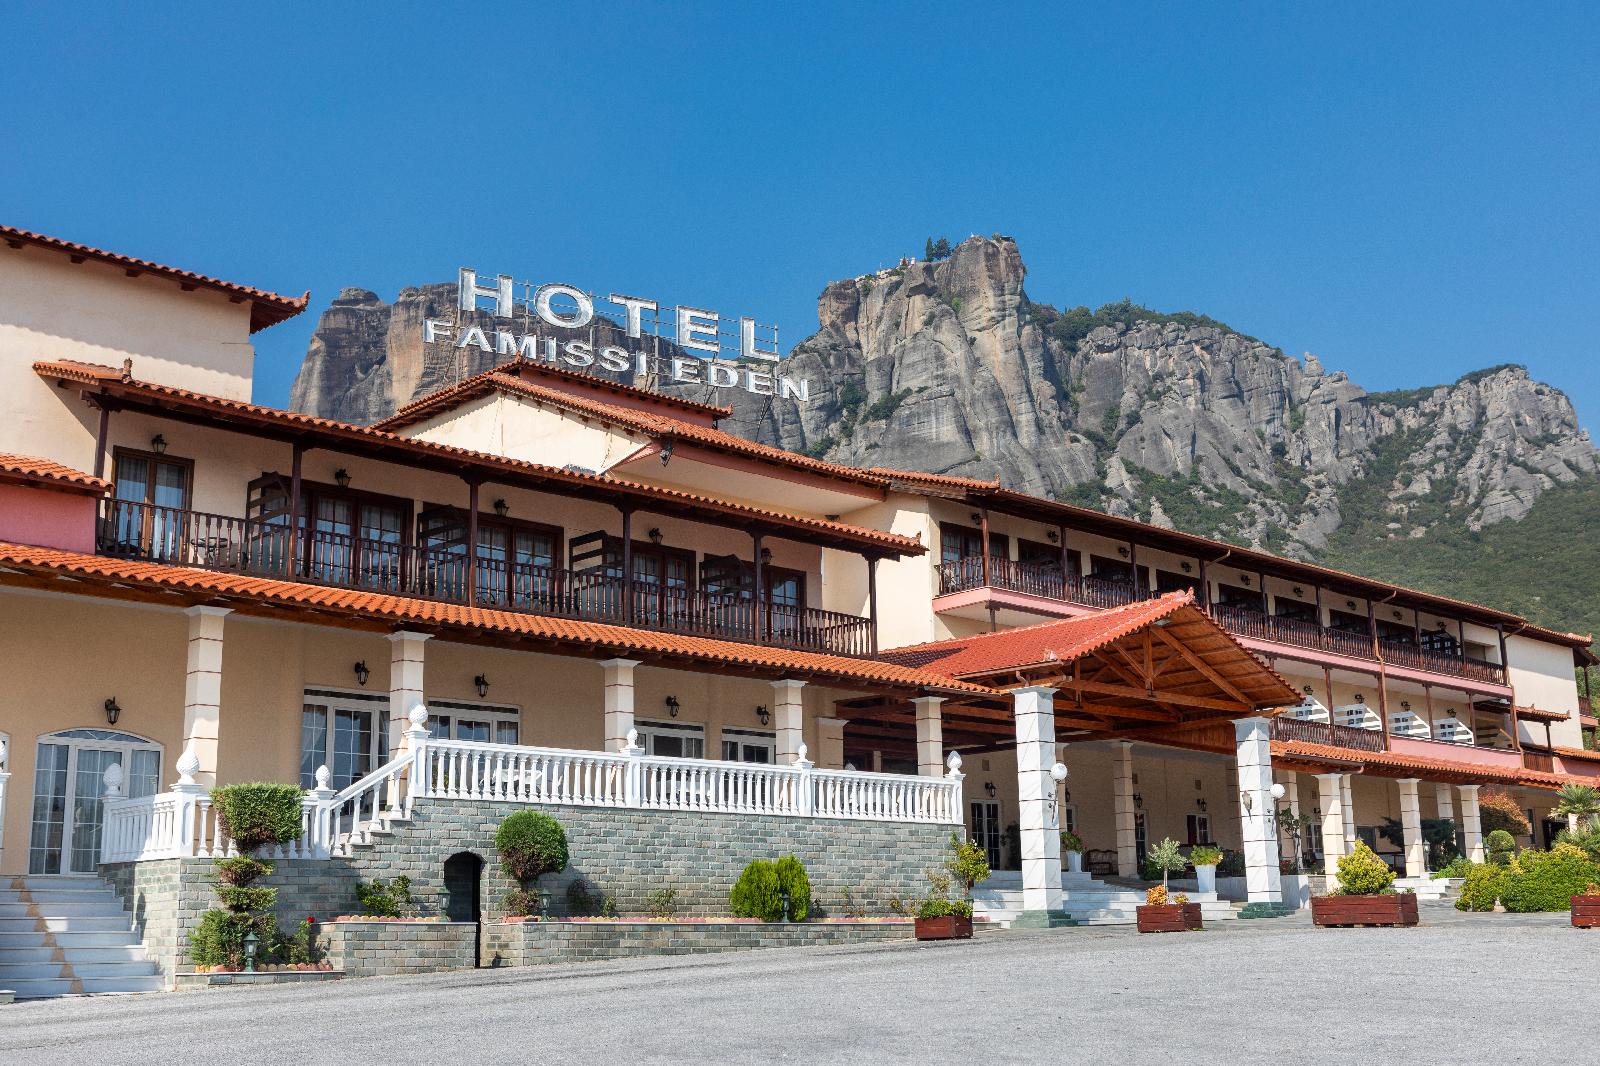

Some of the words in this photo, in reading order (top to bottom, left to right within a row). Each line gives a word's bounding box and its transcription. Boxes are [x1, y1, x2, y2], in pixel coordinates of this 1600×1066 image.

[459, 267, 780, 362] HOTEL
[423, 318, 647, 376] FAMISSI
[673, 357, 809, 402] EDEN
